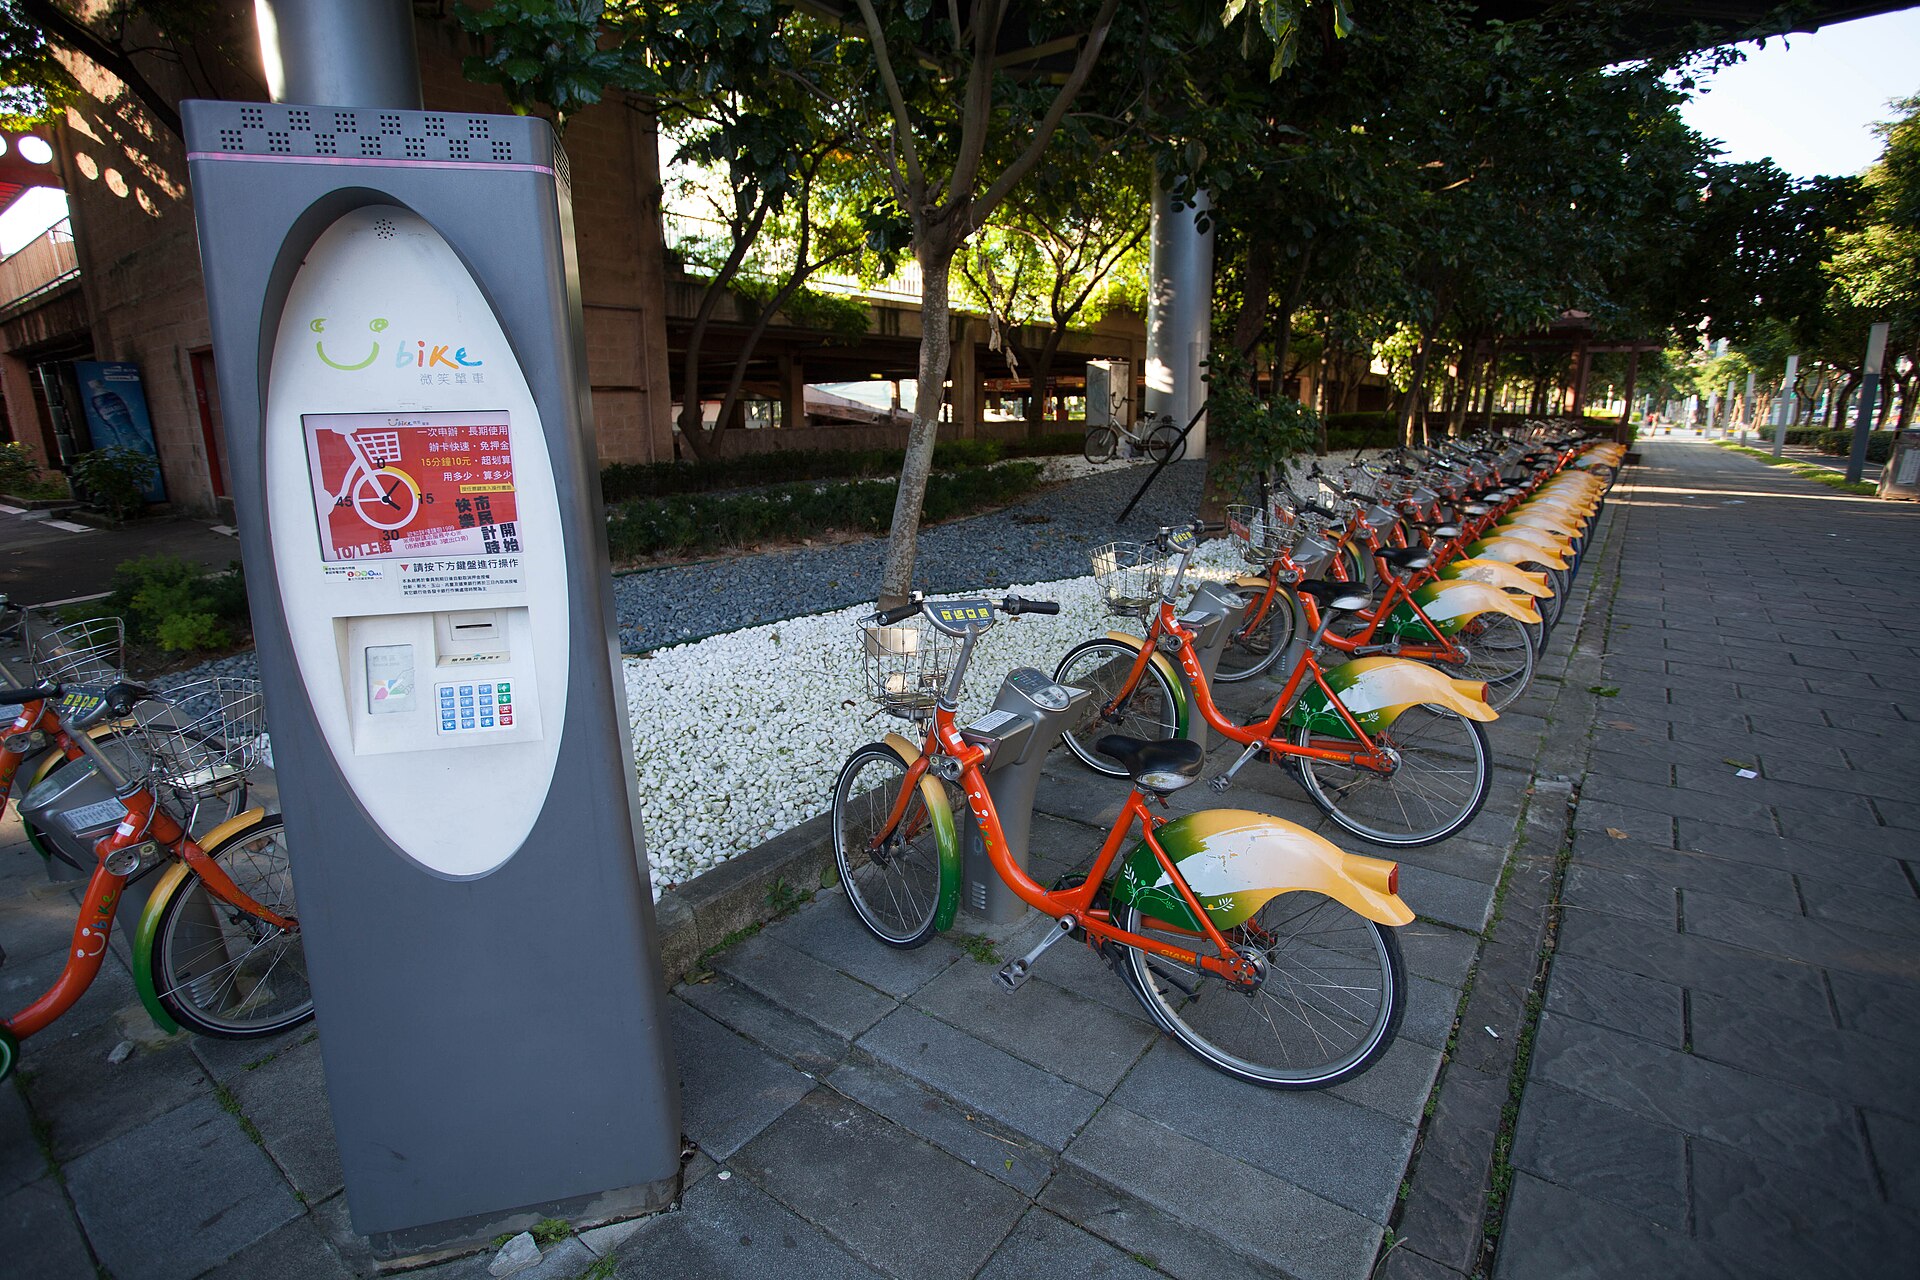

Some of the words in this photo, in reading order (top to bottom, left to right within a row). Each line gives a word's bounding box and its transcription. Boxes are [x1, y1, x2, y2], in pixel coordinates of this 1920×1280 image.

[420, 373, 485, 385] 微笑單車
[335, 496, 353, 507] 45
[418, 493, 434, 504] 15
[383, 530, 399, 540] 30
[413, 559, 519, 573] 請按下方鍵盤進行操作
[1160, 949, 1196, 964] GIANT
